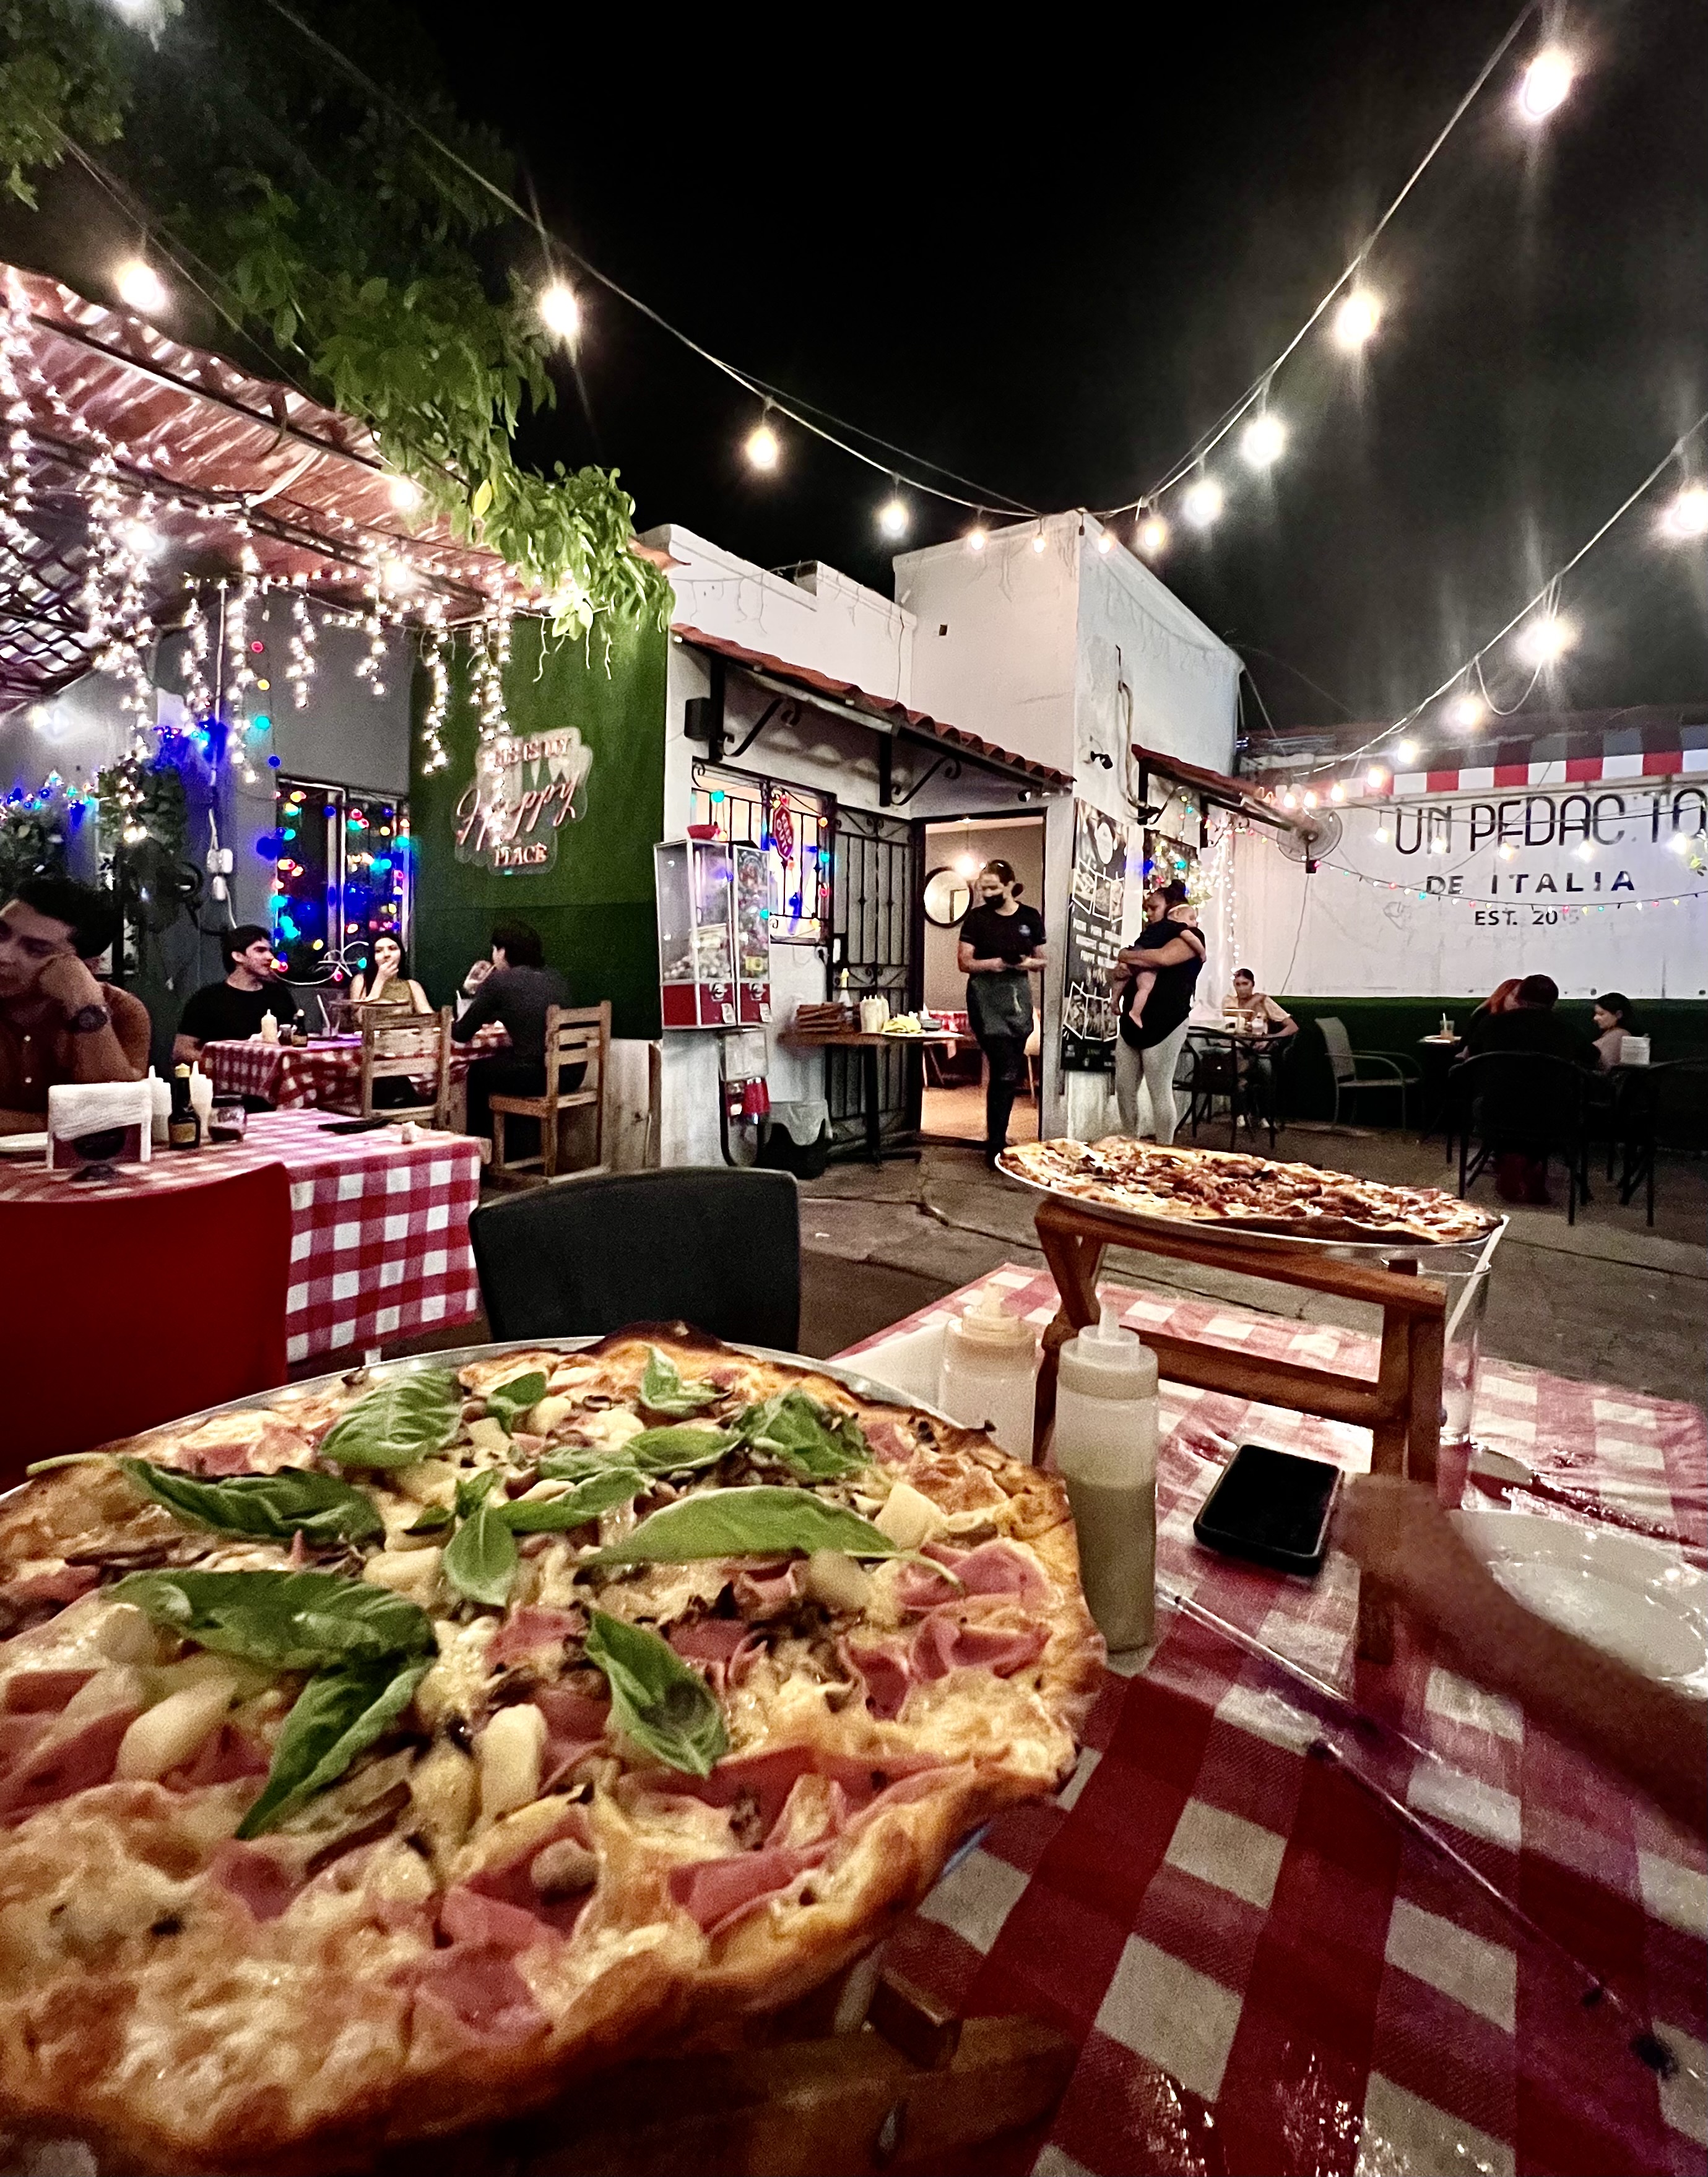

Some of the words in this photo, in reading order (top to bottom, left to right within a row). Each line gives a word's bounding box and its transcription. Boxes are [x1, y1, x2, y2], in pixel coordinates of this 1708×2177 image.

[524, 740, 540, 761] IS
[456, 771, 575, 850] Hppy
[1396, 806, 1452, 855] UN
[495, 843, 547, 866] PLACE
[1426, 876, 1463, 895] DE
[1491, 871, 1635, 894] ITALIA
[1475, 911, 1517, 925] EST.
